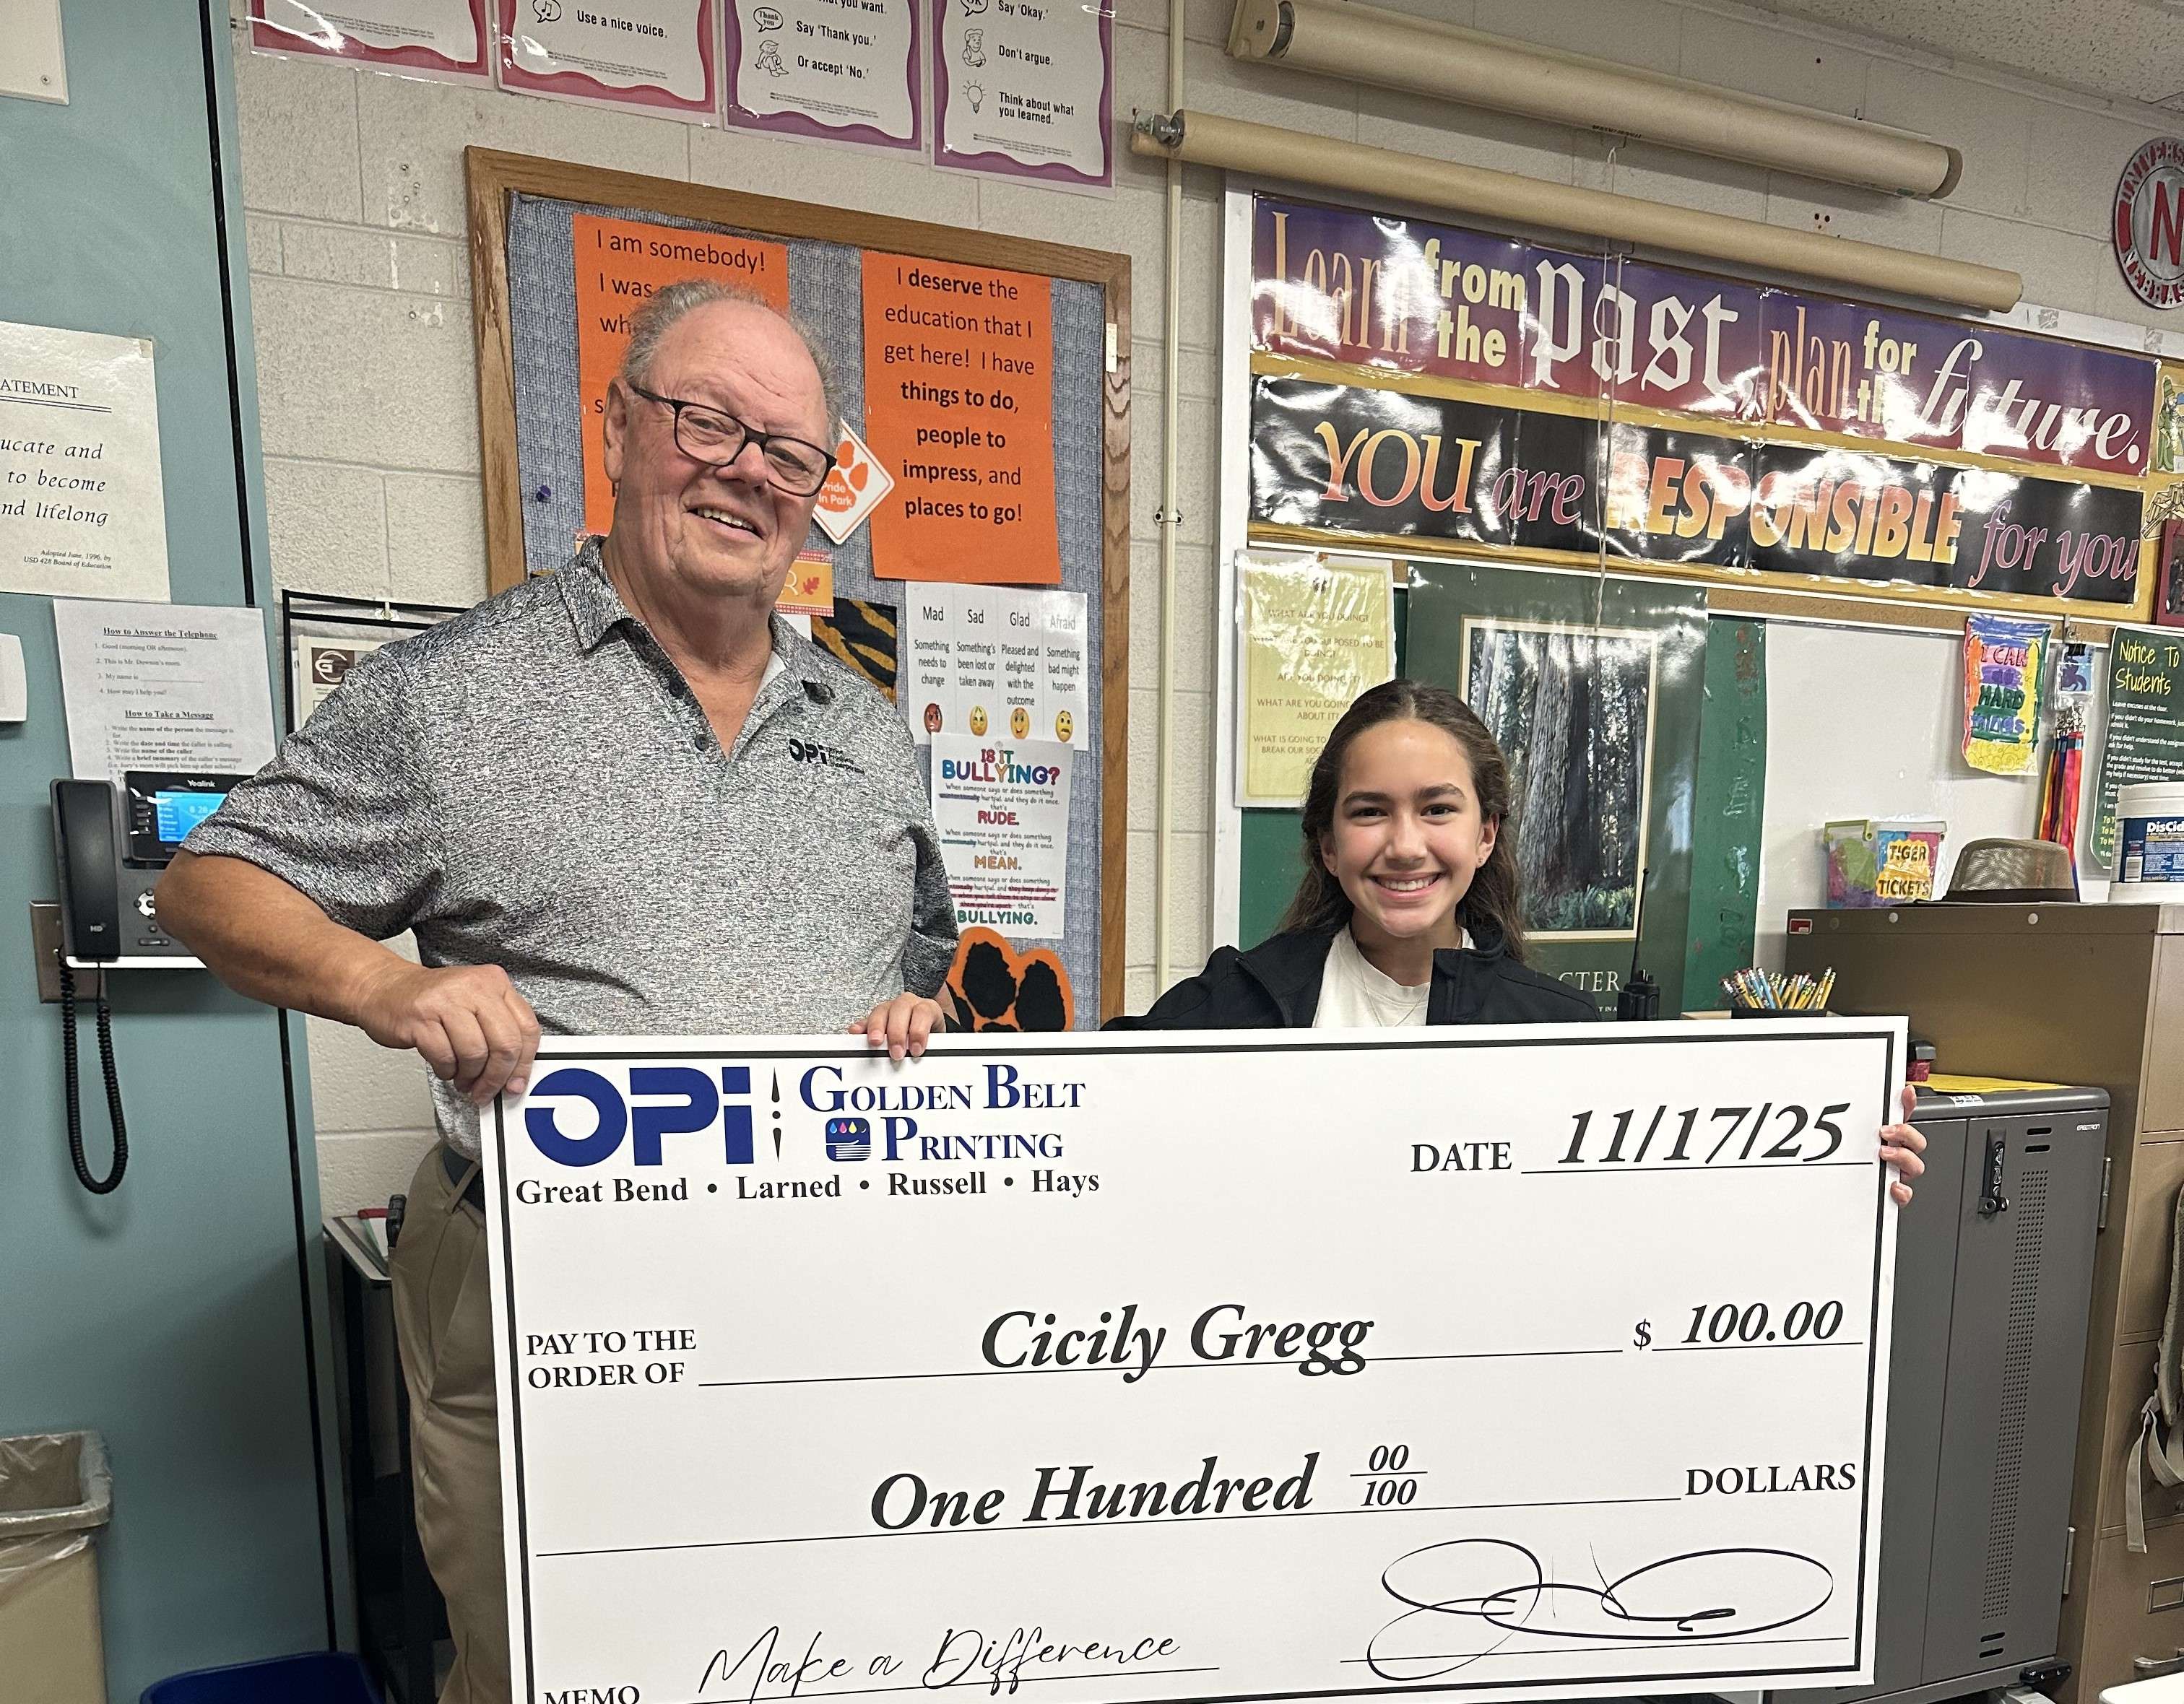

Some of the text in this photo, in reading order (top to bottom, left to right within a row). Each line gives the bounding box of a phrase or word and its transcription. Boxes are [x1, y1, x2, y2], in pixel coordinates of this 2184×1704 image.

[759, 10, 779, 20] Thank
[998, 0, 1015, 16] Say
[577, 9, 668, 38] Use a nice voice.
[797, 20, 815, 37] Say
[797, 55, 809, 68] Or
[812, 60, 843, 76] accept
[999, 45, 1054, 66] Don't argue.
[999, 91, 1074, 116] Think about what
[999, 107, 1054, 125] you learned.
[597, 229, 766, 274] I am somebody!
[599, 272, 653, 297] I was
[898, 267, 1018, 300] I deserve the
[1424, 238, 1525, 311] from
[885, 304, 1032, 339] education that I
[1436, 309, 1507, 368] the
[884, 344, 1035, 375] get here! I have
[1769, 305, 1852, 425] plan
[1863, 320, 1918, 375] for
[1, 379, 79, 399] ATEMENT
[901, 381, 1019, 413] things to do,
[1918, 338, 2141, 464] future.
[916, 426, 1006, 448] people to
[1, 438, 103, 460] ucate and
[7, 469, 106, 493] to become
[903, 459, 1021, 486] impress, and
[821, 482, 846, 493] Pride
[831, 495, 853, 507] Park
[905, 497, 1022, 524] places to go!
[1314, 420, 2139, 596] YOU are RESPONSIBLE for you
[35, 503, 109, 528] lifelong
[923, 606, 944, 621] Mad
[967, 609, 984, 624] Sad
[1010, 612, 1030, 627] Glad
[1050, 615, 1075, 630] Afraid
[103, 627, 121, 635] How
[914, 639, 950, 653] Something
[957, 641, 996, 656] Something's
[1001, 644, 1039, 656] Pleased and
[1047, 647, 1080, 661] Something
[1993, 647, 2028, 666] CAN
[2119, 639, 2180, 668] Notice To
[919, 658, 947, 669] needs to
[958, 658, 974, 670] been
[975, 659, 987, 671] lost
[1005, 661, 1035, 674] delighted
[1048, 664, 1080, 677] bad might
[921, 674, 945, 687] change
[959, 676, 994, 690] taken away
[1008, 678, 1034, 690] with the
[1052, 679, 1075, 692] happen
[2115, 666, 2171, 695] Students
[1006, 696, 1035, 706] outcome
[1304, 700, 1322, 708] YOU
[1978, 684, 2025, 710] HARD
[981, 748, 1014, 764] IS IT
[942, 760, 1060, 786] BULLYING?
[978, 810, 1020, 826] RUDE.
[974, 856, 1022, 871] MEAN.
[1889, 845, 1926, 861] TIGER
[1878, 879, 1931, 896] TICKETS
[957, 910, 1038, 925] BULLYING.
[800, 1065, 973, 1113] GOLDEN
[982, 1064, 1086, 1110] BELT
[880, 1116, 1063, 1162] PRINTING
[1410, 1102, 1851, 1173] DATE 11/17/25
[516, 1168, 1100, 1206] Great Bend Larned Russell Hays
[526, 1329, 698, 1357] PAY TO THE
[981, 1300, 1845, 1383] Cicily Gregg $ 100.00
[527, 1362, 685, 1390] ORDER OF
[870, 1444, 1856, 1530] One Hundred 00 DOLLARS
[1359, 1477, 1418, 1507] 100
[544, 1625, 1181, 1704] MEMO Make a Difference
